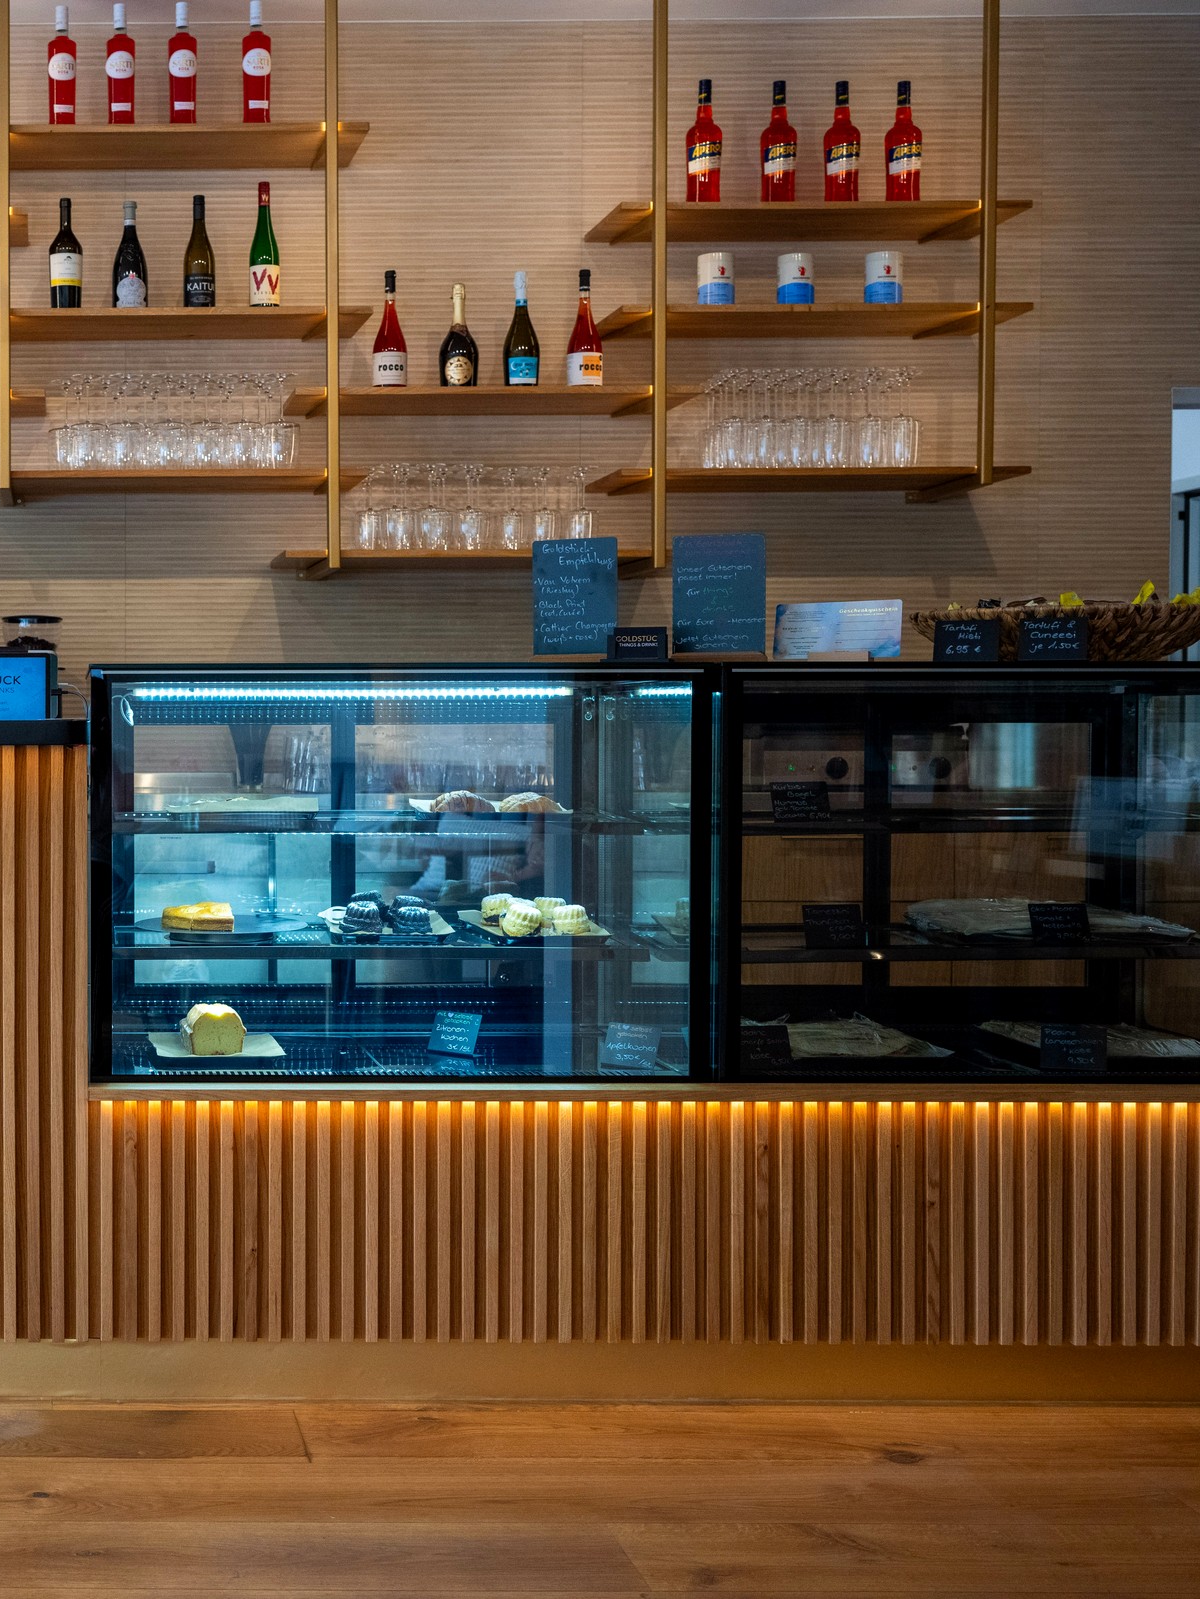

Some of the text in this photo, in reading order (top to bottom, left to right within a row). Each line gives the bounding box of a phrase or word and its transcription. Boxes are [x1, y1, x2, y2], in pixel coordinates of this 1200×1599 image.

[692, 144, 721, 158] APERO
[768, 146, 796, 159] APERO
[831, 146, 860, 159] APERO
[893, 145, 921, 159] APERO
[615, 634, 658, 642] GOLDSTÜC
